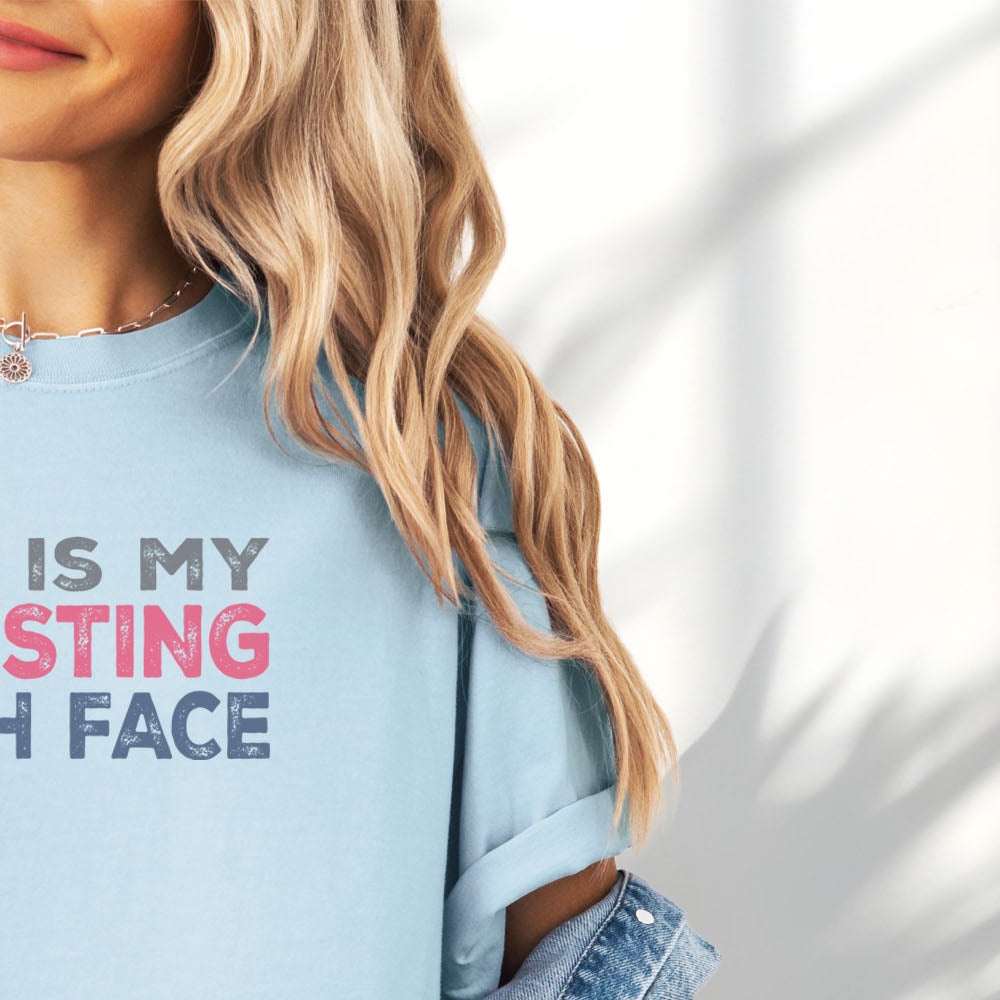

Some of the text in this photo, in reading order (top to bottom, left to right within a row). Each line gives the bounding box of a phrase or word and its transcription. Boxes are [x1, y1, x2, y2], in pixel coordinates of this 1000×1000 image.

[28, 537, 102, 591] IS
[140, 537, 269, 591] MY
[69, 691, 270, 760] FACE
